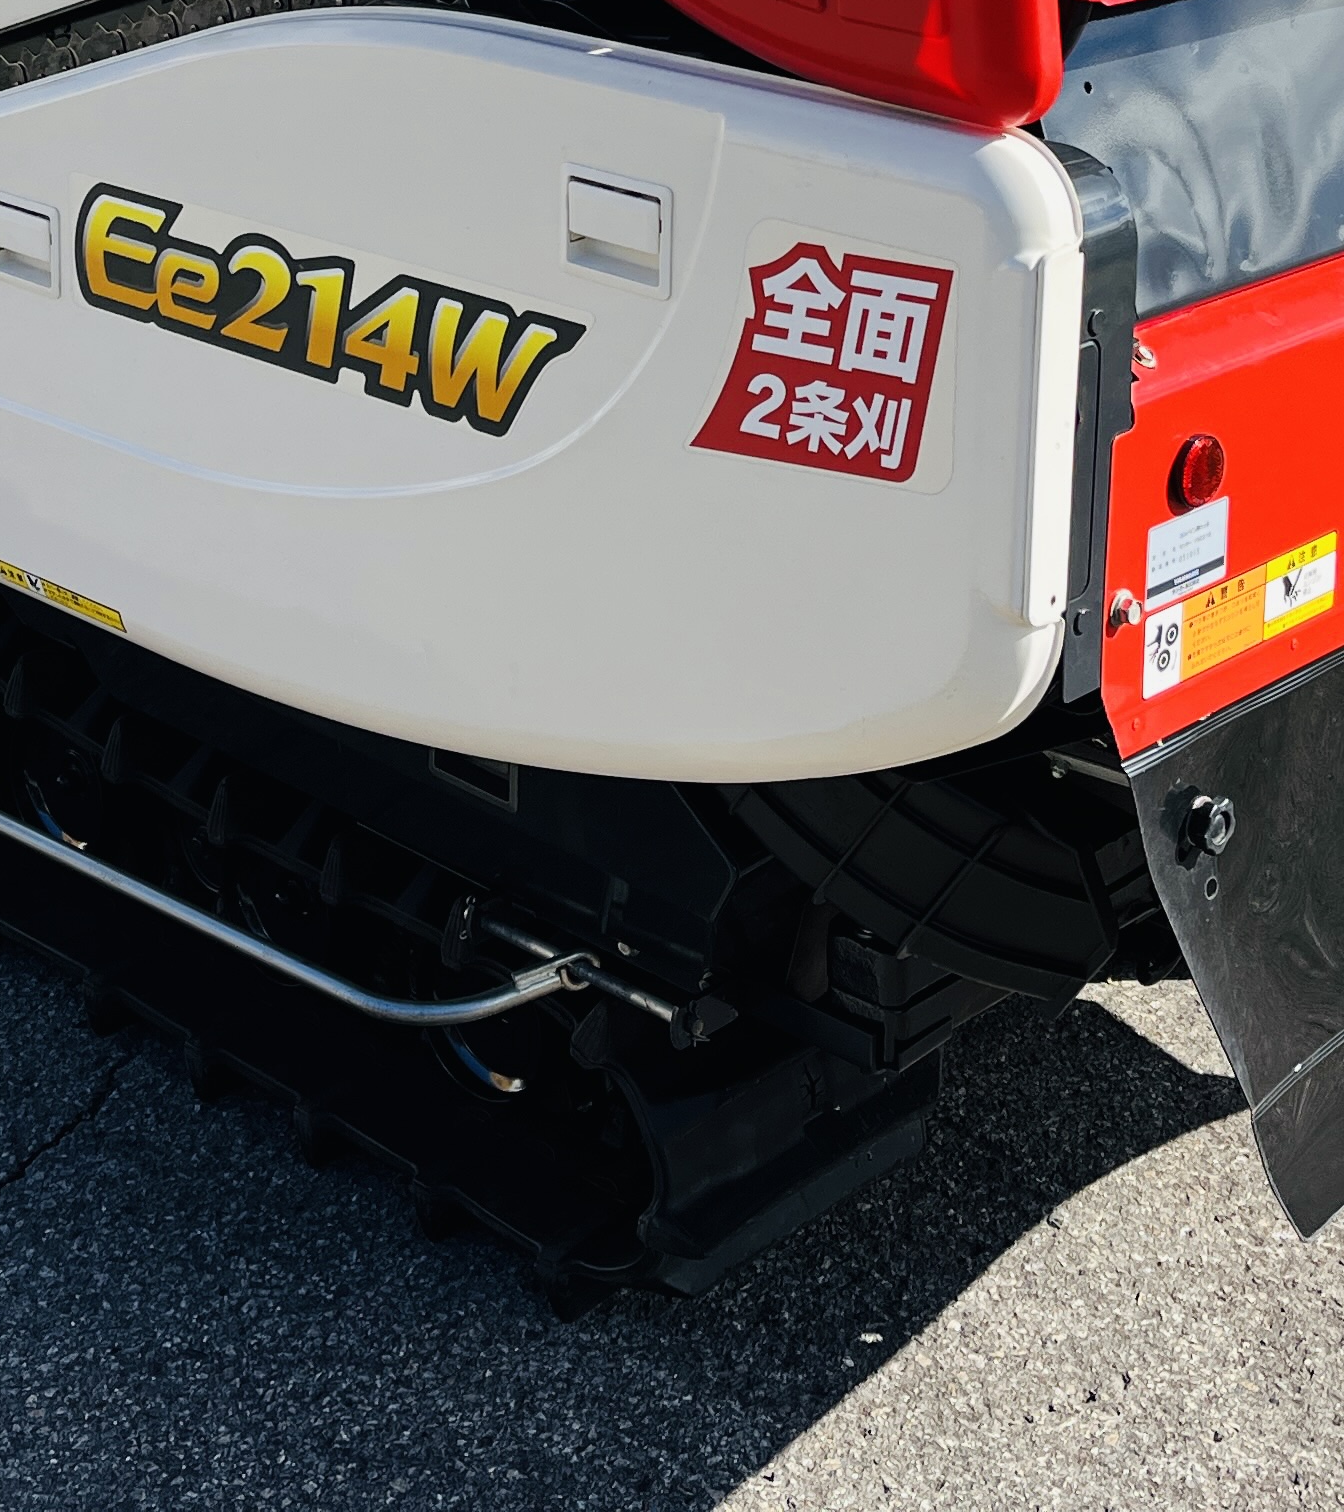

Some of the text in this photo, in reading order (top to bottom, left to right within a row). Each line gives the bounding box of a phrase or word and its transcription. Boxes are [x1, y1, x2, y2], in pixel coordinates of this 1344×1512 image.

[83, 193, 559, 424] Ee214W
[751, 256, 939, 384] 全面
[739, 373, 912, 470] 2条刈
